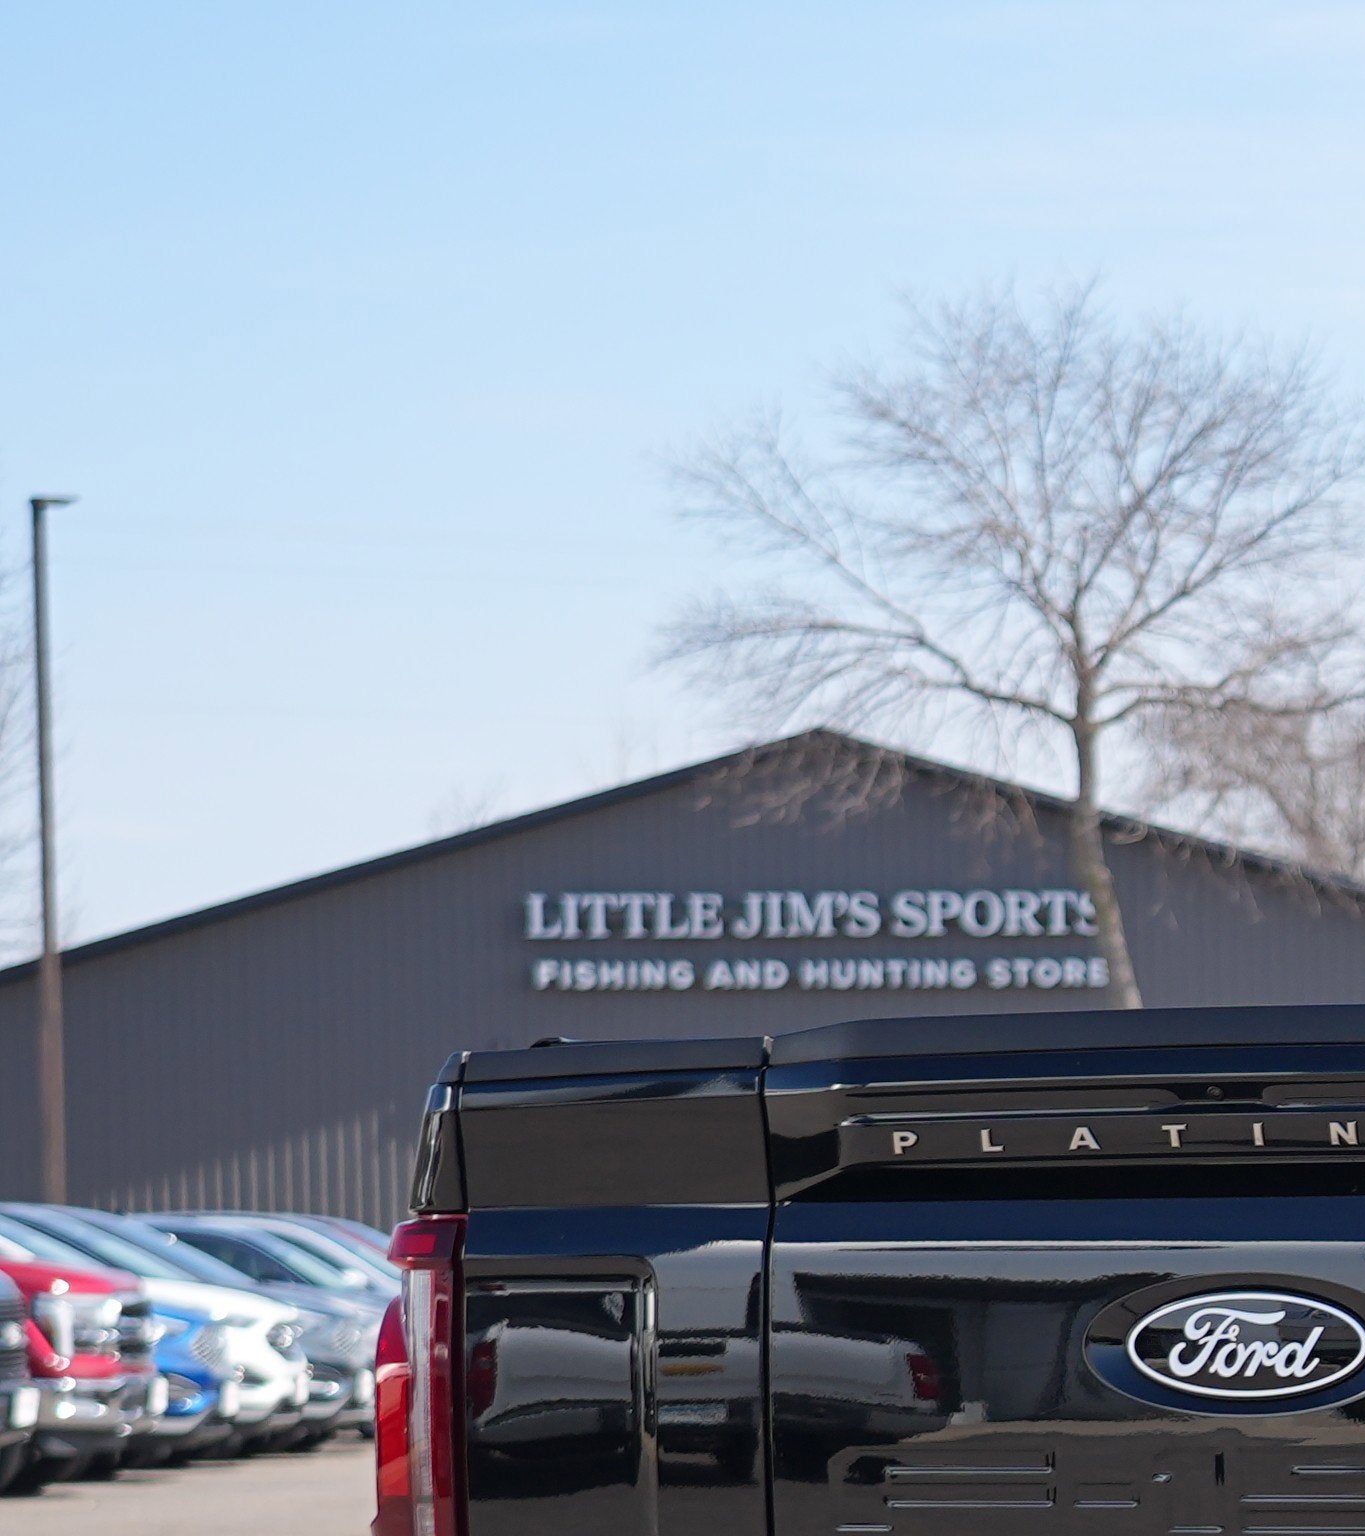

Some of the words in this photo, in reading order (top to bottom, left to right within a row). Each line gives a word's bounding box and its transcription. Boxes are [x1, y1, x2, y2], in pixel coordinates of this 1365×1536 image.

[524, 891, 725, 939] LITTLE
[730, 889, 882, 939] JIM'S
[532, 958, 696, 991] FISHING
[704, 959, 790, 991] AND
[800, 957, 978, 991] HUNTING
[984, 957, 1111, 989] STORE
[1167, 1306, 1326, 1380] Ford
